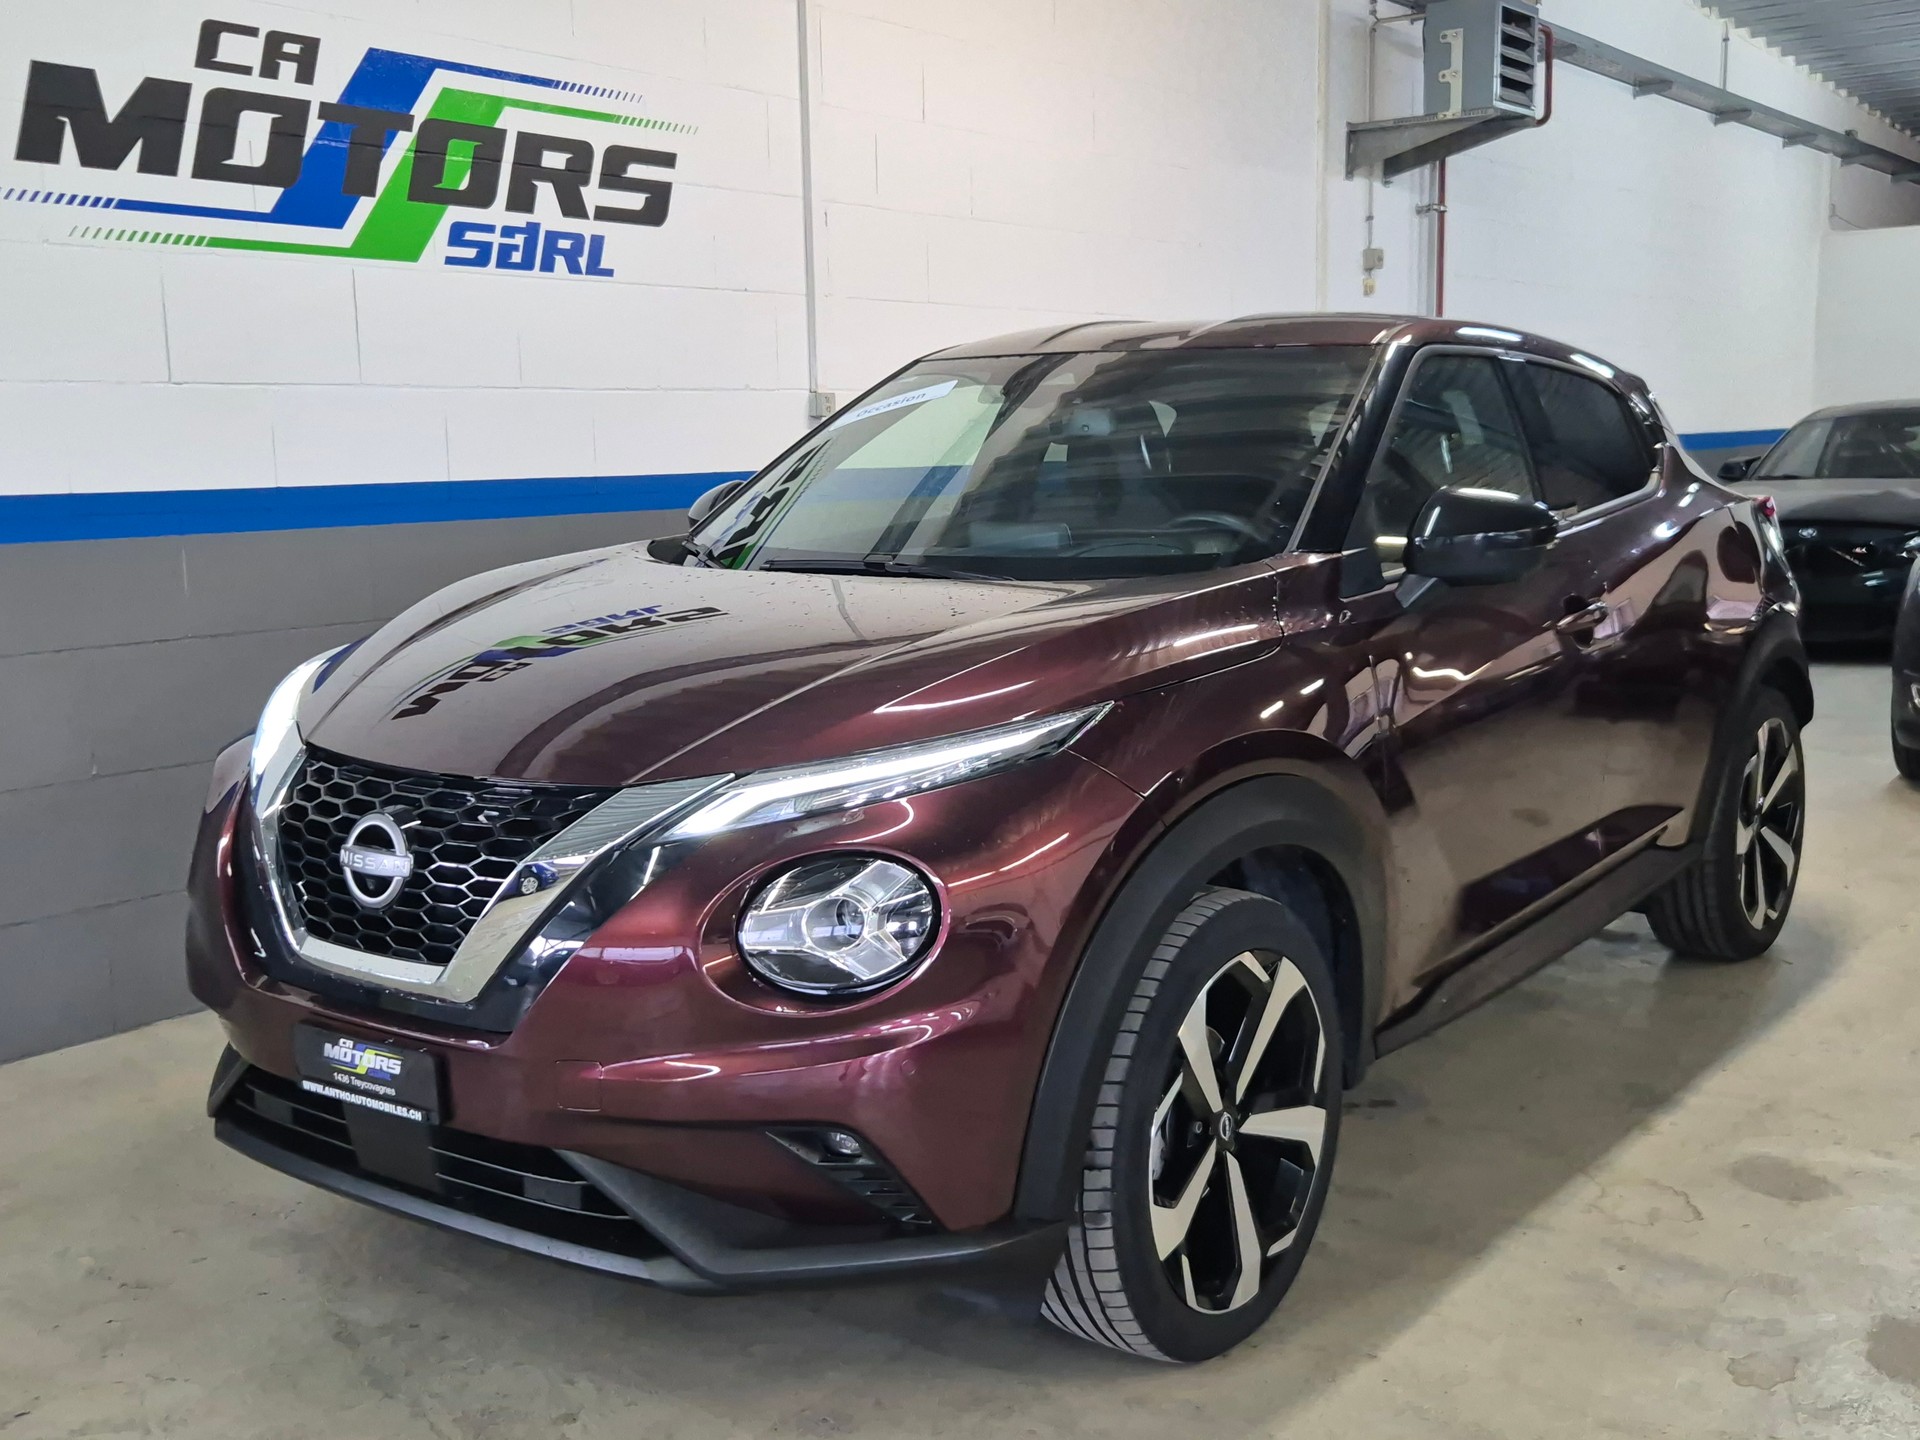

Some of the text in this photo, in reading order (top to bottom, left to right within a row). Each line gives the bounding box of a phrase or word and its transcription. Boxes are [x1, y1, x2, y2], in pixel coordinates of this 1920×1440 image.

[194, 19, 321, 86] CA
[15, 59, 677, 228] MOTORS
[340, 849, 409, 873] NISSAN
[324, 1043, 402, 1075] MOTORS
[339, 1038, 354, 1049] CA
[302, 1080, 422, 1121] WWW.ANTHOAUTOMOBILES.CH
